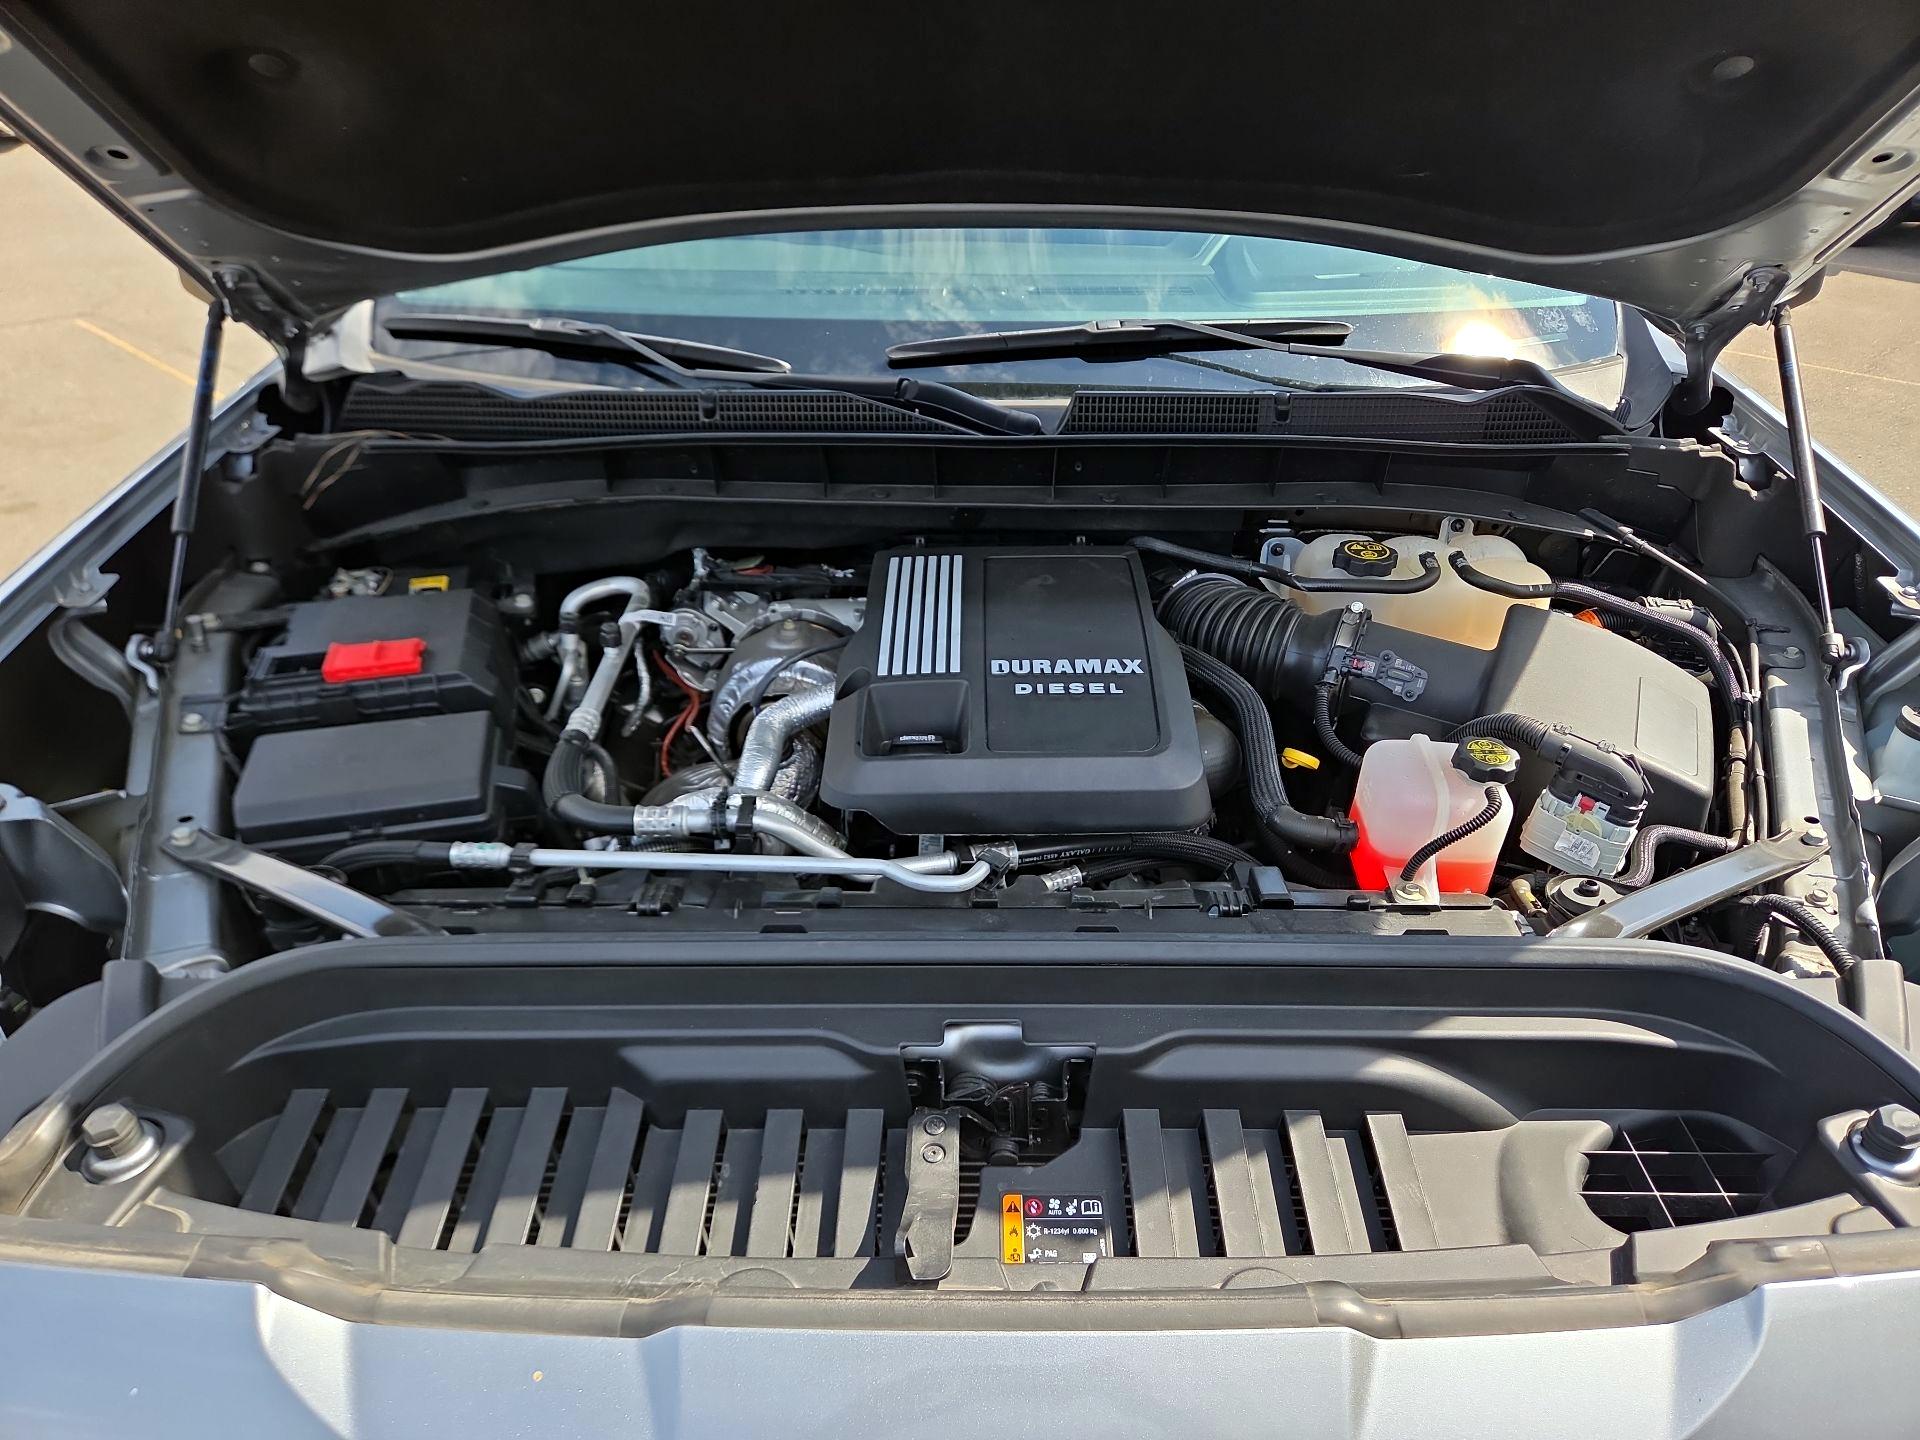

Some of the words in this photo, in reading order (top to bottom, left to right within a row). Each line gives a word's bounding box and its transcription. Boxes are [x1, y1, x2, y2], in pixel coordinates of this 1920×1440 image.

[990, 658, 1145, 675] DURAMAX
[1014, 682, 1124, 695] DIESEL
[1059, 848, 1091, 858] GALAXY
[1043, 1227, 1070, 1236] R-1234yf
[1090, 1227, 1098, 1236] kg
[1044, 1249, 1058, 1258] PAG
